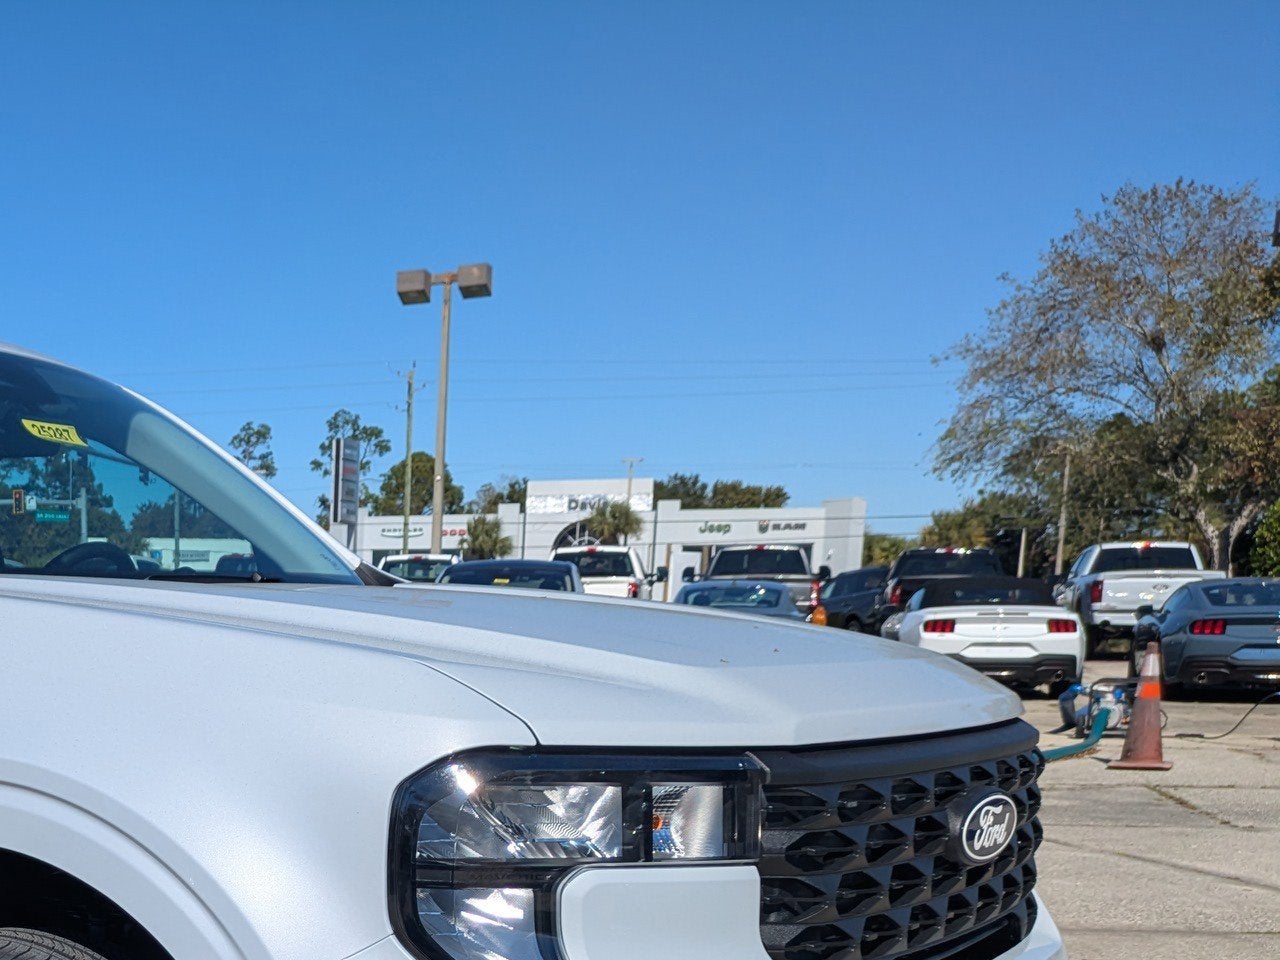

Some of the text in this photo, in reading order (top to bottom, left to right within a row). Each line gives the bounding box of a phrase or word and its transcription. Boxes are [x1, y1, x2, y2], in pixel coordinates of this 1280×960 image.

[699, 521, 731, 535] Jeep
[772, 522, 807, 531] RAM
[974, 804, 1010, 851] Ford
